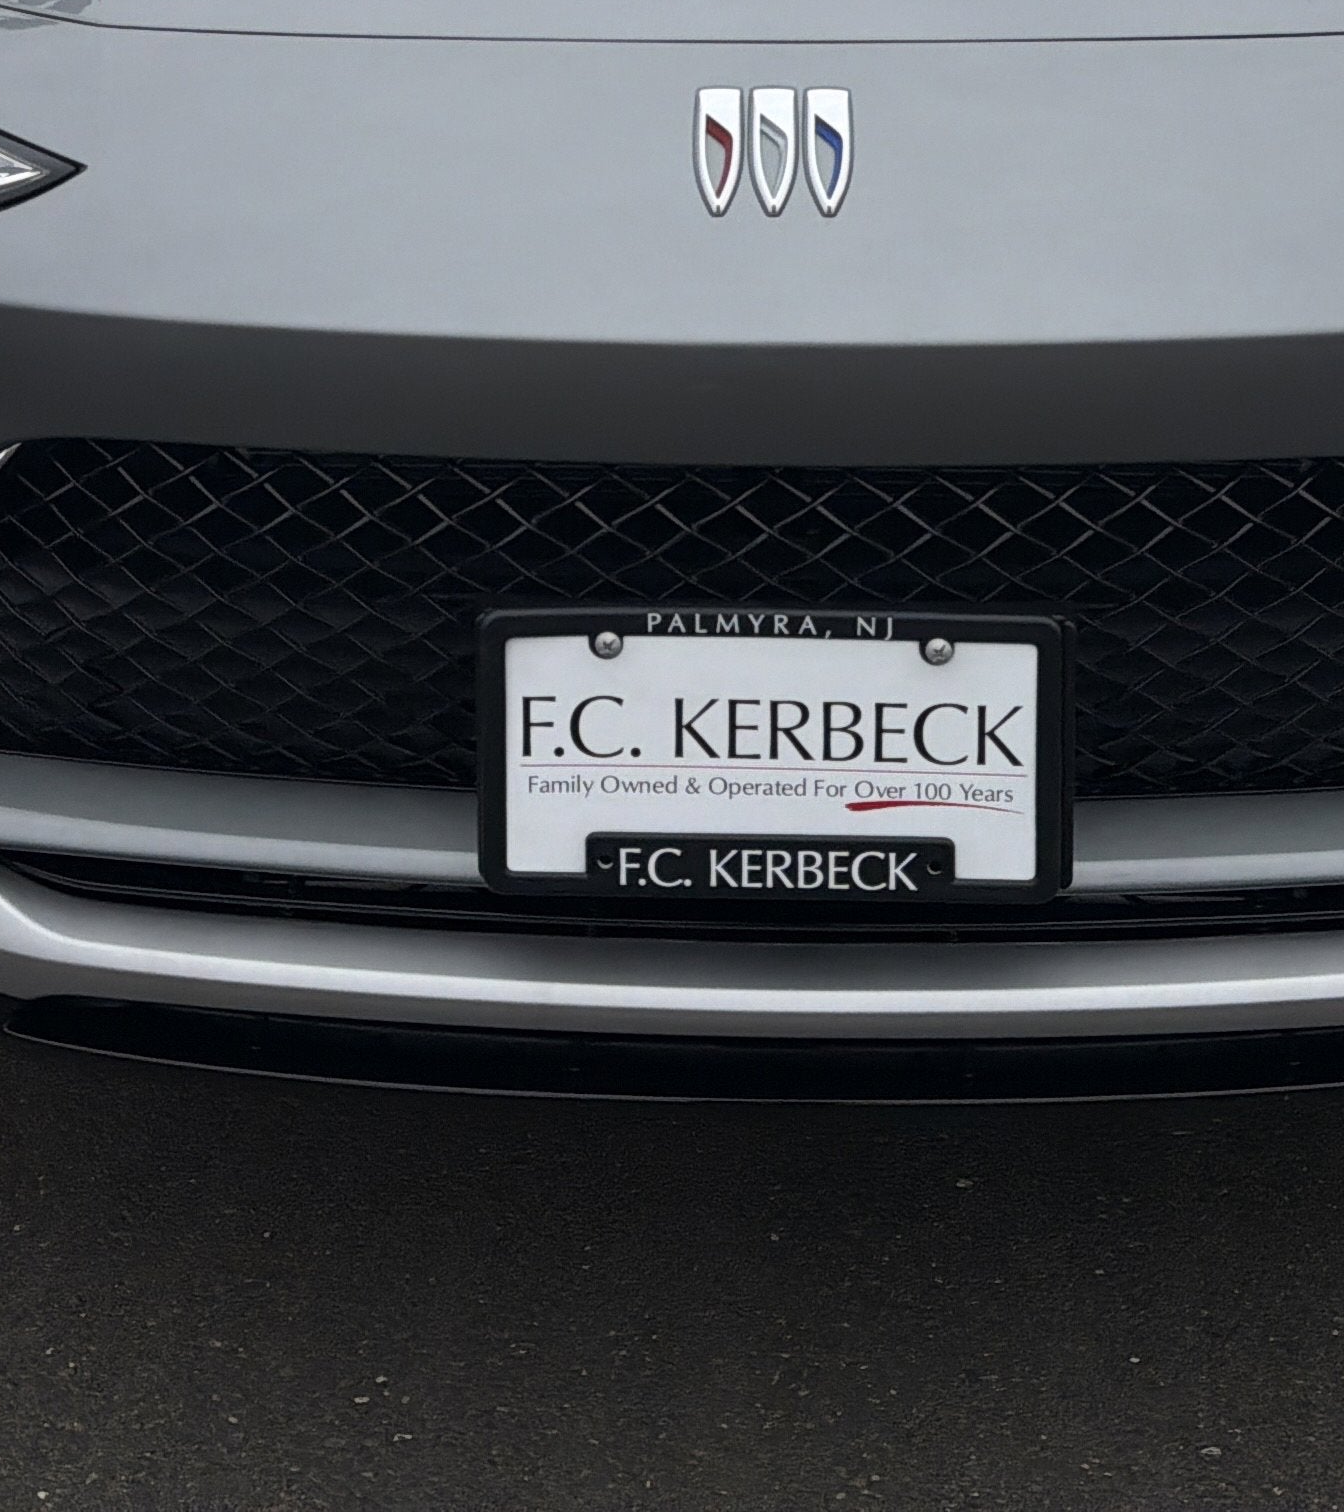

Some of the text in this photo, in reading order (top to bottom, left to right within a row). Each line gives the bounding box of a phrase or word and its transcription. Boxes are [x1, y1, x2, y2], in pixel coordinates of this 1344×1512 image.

[647, 612, 895, 640] PALMYRA, NJ
[521, 695, 1025, 767] F.C. KERBECK
[527, 774, 1014, 803] Family Owned & Operated For Over 100 Years
[618, 847, 919, 891] F.C. KERBECK
